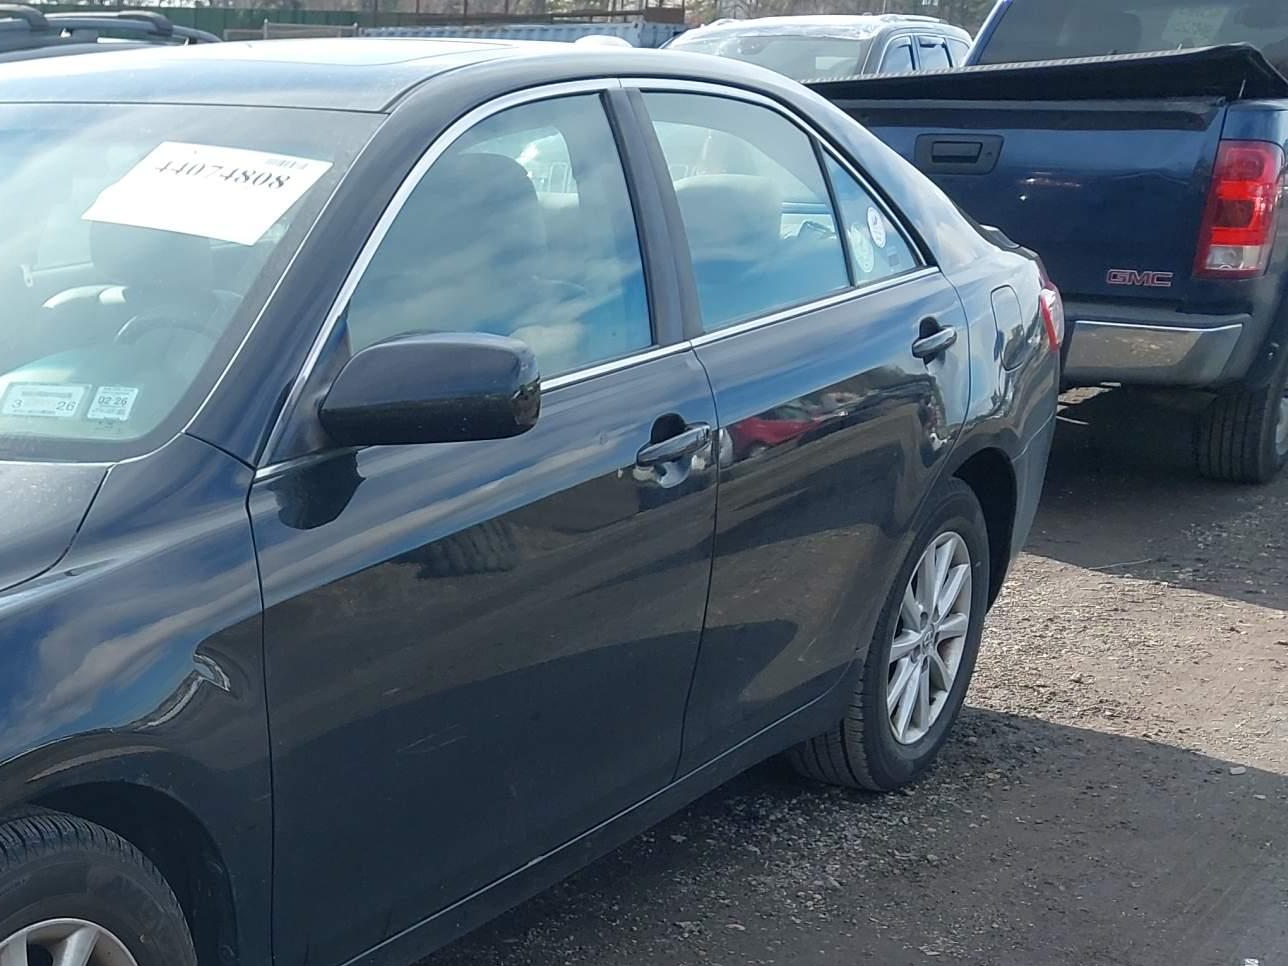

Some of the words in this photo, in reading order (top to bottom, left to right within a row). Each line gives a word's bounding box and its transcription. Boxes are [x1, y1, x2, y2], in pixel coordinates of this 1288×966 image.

[155, 159, 291, 190] 44074808
[1106, 268, 1174, 287] GMC
[55, 400, 77, 412] 26
